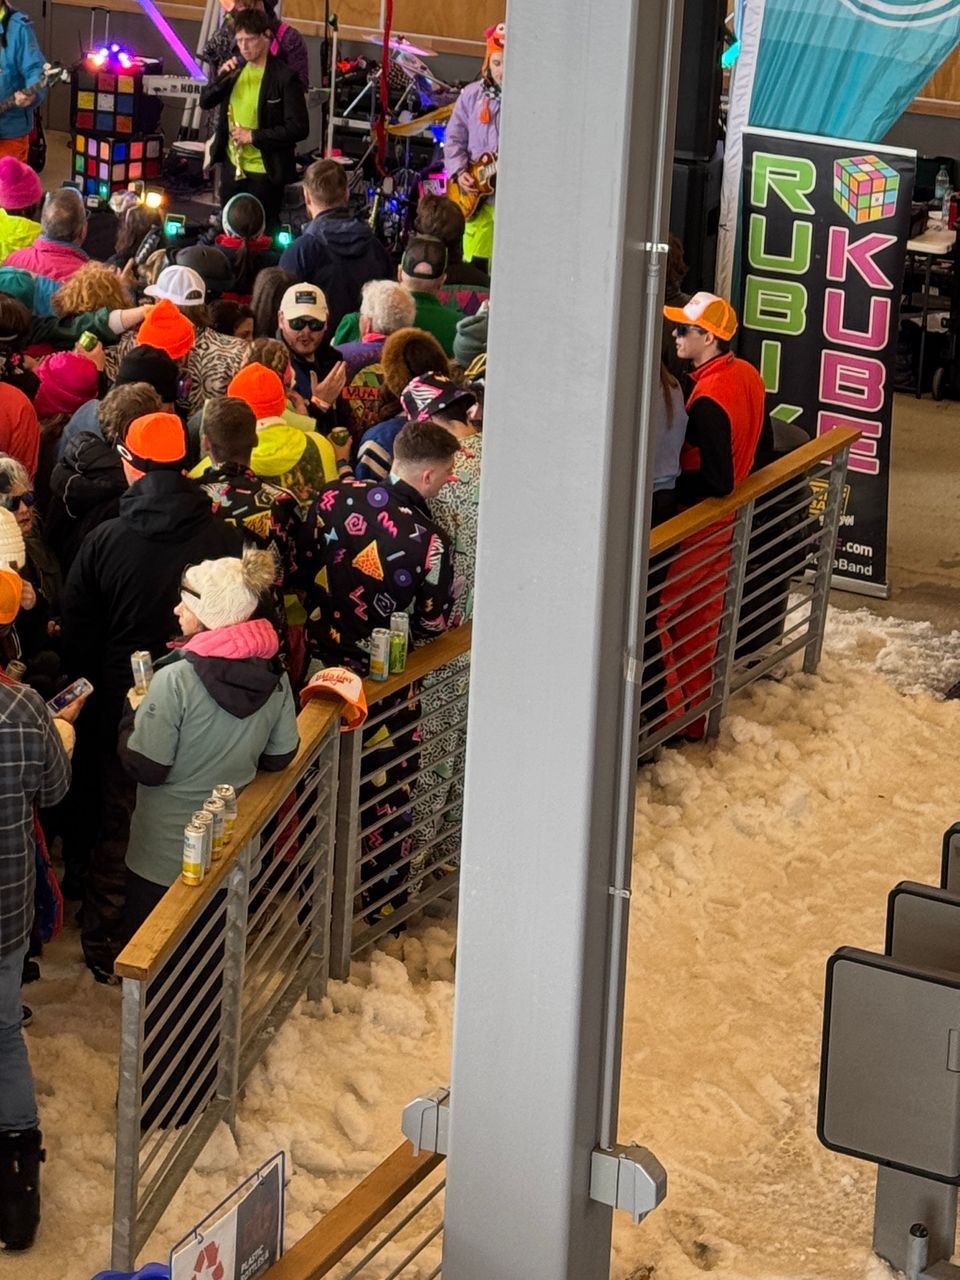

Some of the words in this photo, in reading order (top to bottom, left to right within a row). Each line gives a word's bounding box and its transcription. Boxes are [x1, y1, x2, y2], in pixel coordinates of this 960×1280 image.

[743, 151, 816, 423] RUBI
[817, 225, 897, 475] KUBE
[241, 1244, 264, 1274] PLASTIC
